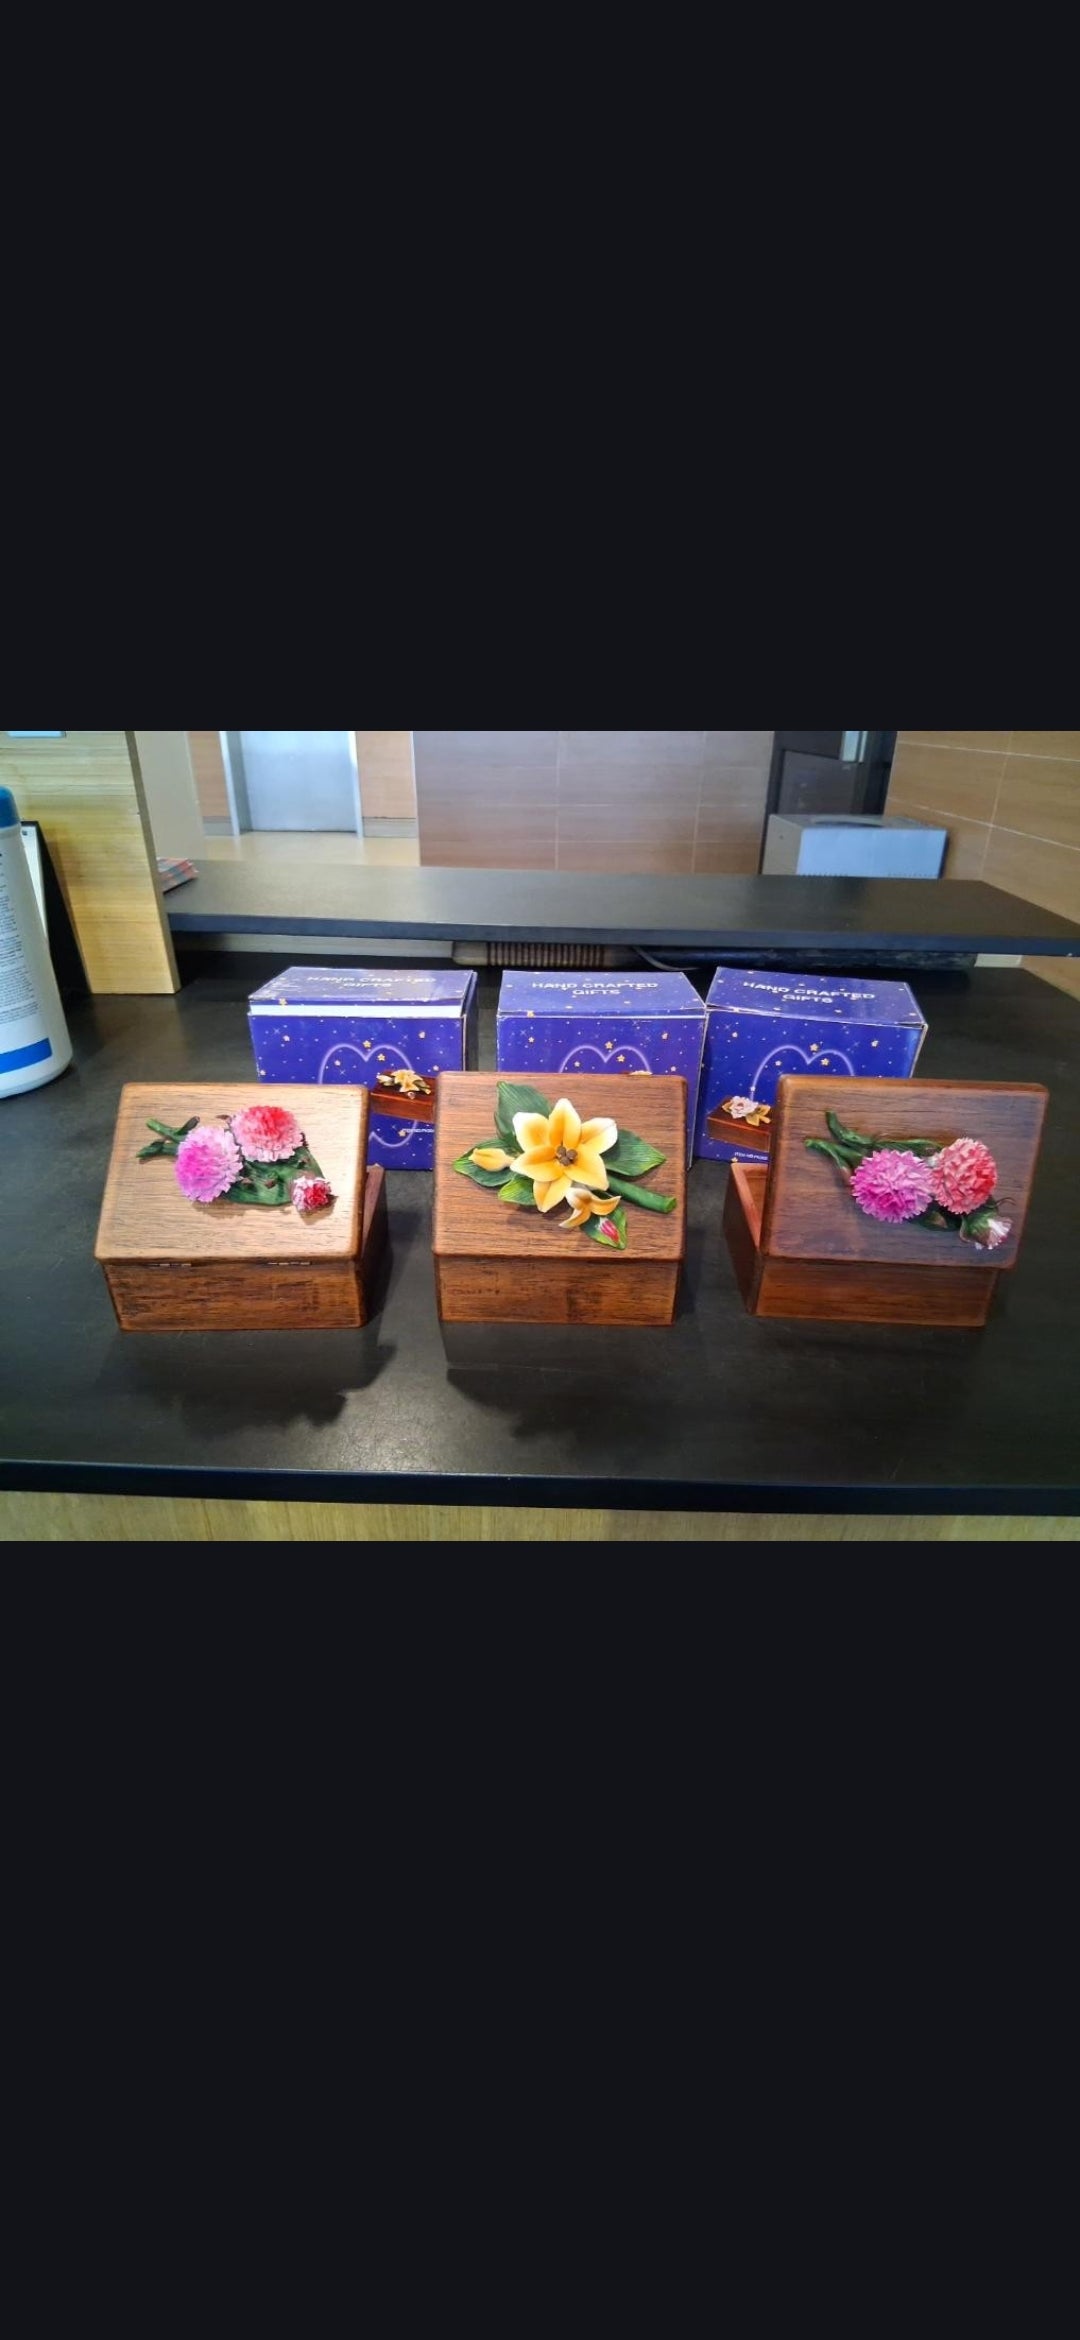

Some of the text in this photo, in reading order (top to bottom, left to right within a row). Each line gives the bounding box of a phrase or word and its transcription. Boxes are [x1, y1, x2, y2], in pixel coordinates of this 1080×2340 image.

[743, 981, 876, 999] HAND CRAFTED
[782, 994, 833, 1004] GIFTS
